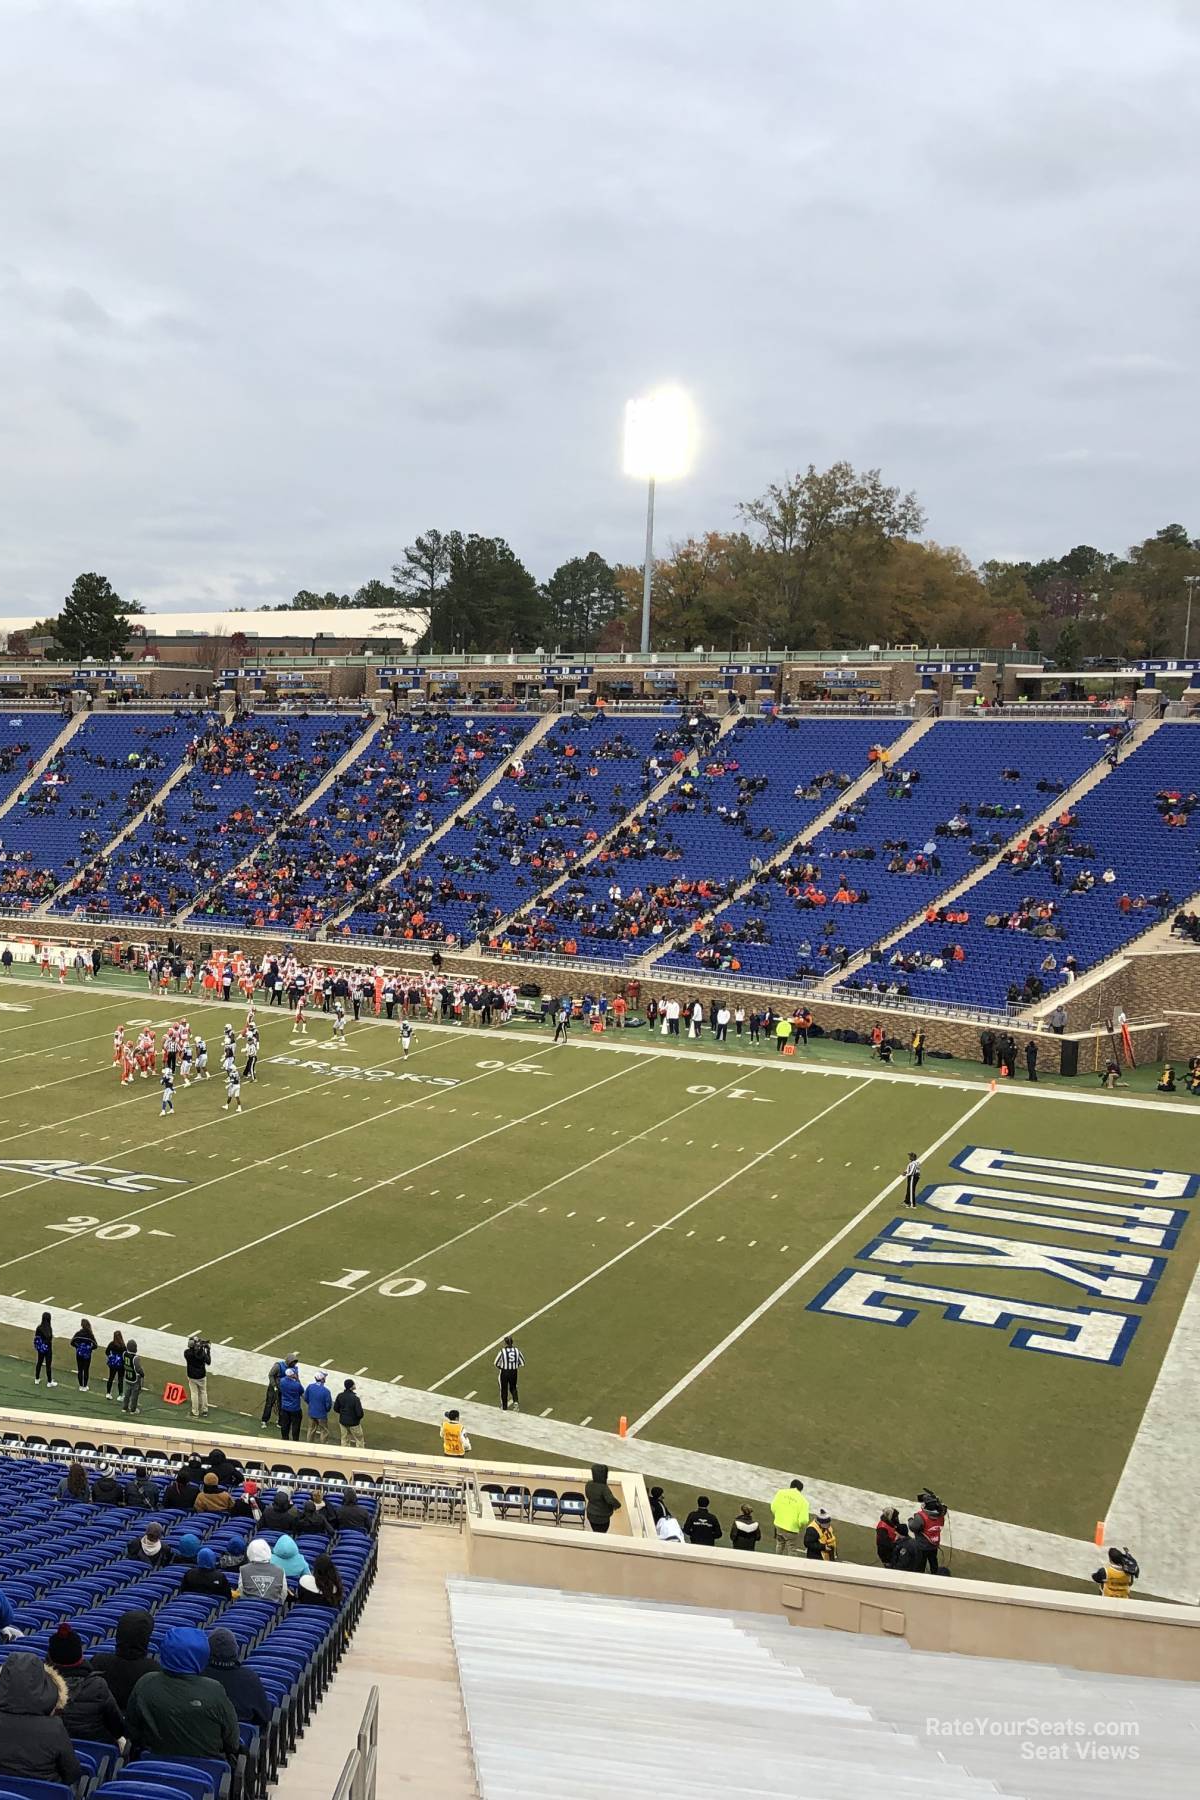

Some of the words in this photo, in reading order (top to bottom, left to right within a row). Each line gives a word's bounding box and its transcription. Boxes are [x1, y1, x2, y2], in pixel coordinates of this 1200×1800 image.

[266, 1056, 462, 1087] BROOKS
[44, 1215, 141, 1240] 20
[805, 1145, 1200, 1367] DUKE
[319, 1267, 428, 1297] 10
[508, 1352, 516, 1363] S
[167, 1386, 179, 1399] 10
